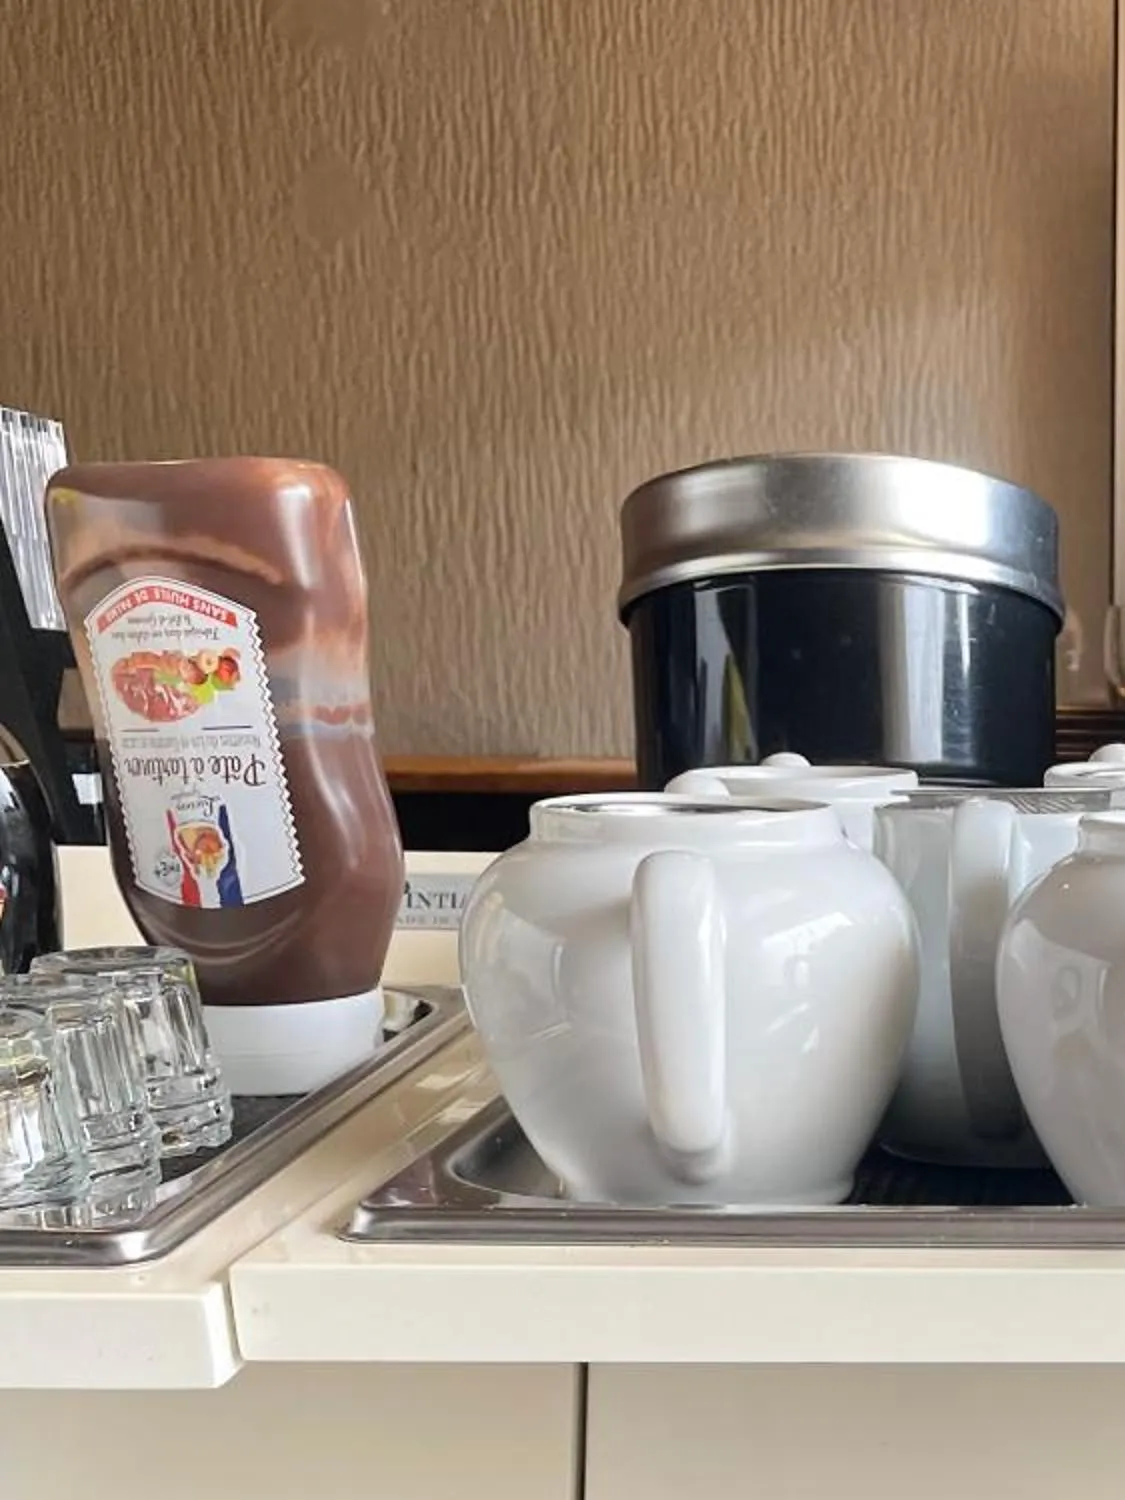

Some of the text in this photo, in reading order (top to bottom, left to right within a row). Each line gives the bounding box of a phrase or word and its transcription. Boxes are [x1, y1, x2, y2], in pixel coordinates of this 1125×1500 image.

[123, 752, 267, 787] Pâte à tartiner
